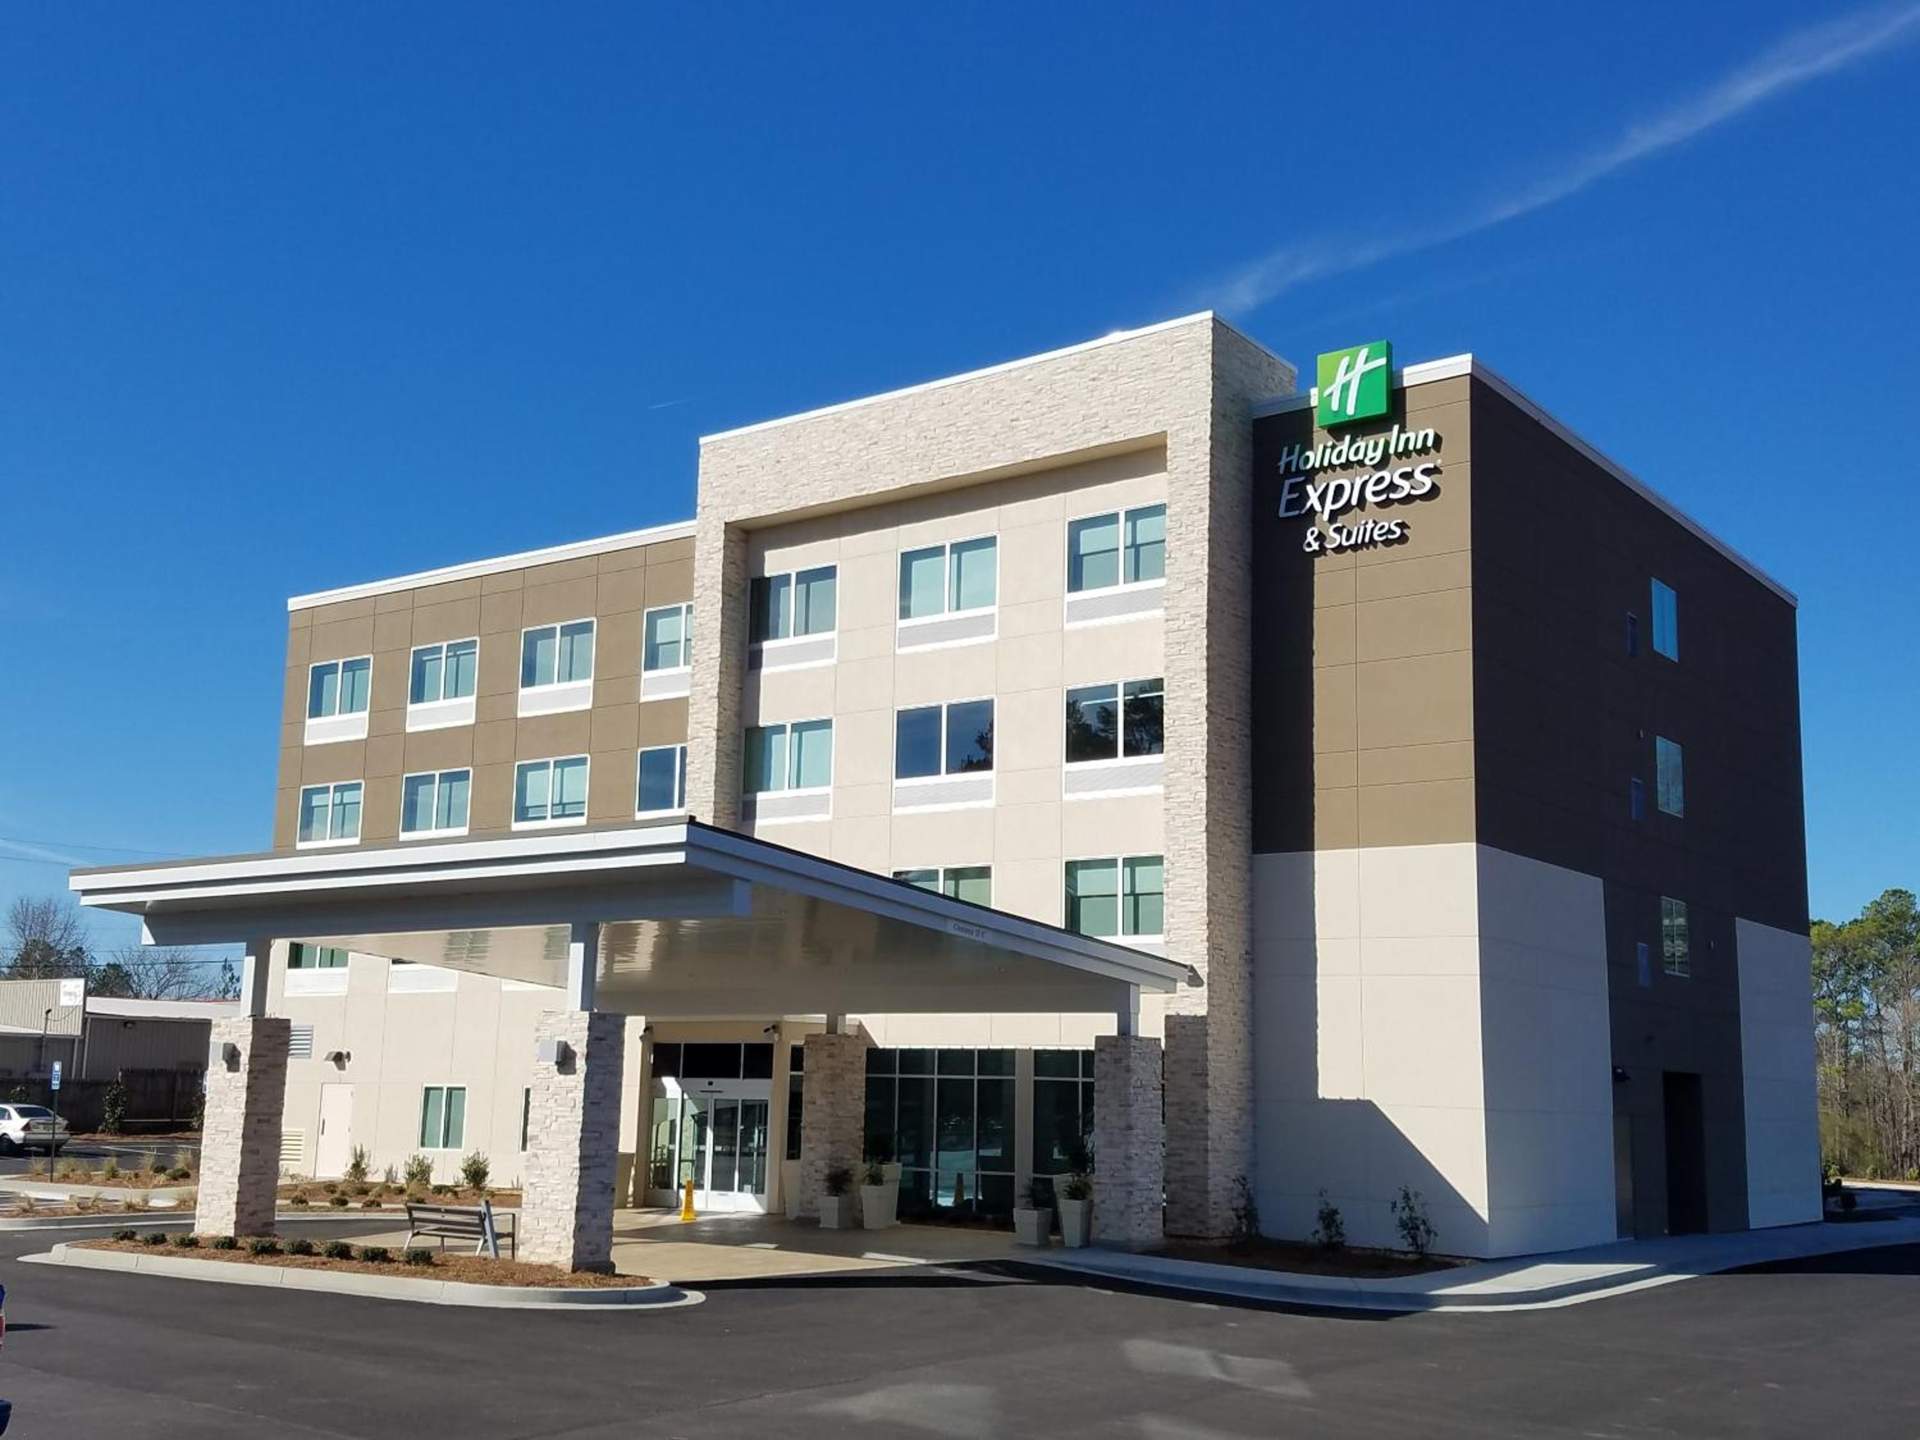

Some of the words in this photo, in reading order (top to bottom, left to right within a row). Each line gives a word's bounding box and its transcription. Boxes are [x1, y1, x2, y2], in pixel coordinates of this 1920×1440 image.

[1278, 434, 1386, 475] Holiday
[1388, 424, 1435, 454] Inn
[1278, 463, 1436, 522] Express
[1303, 526, 1321, 553] &
[1324, 519, 1403, 549] Suites
